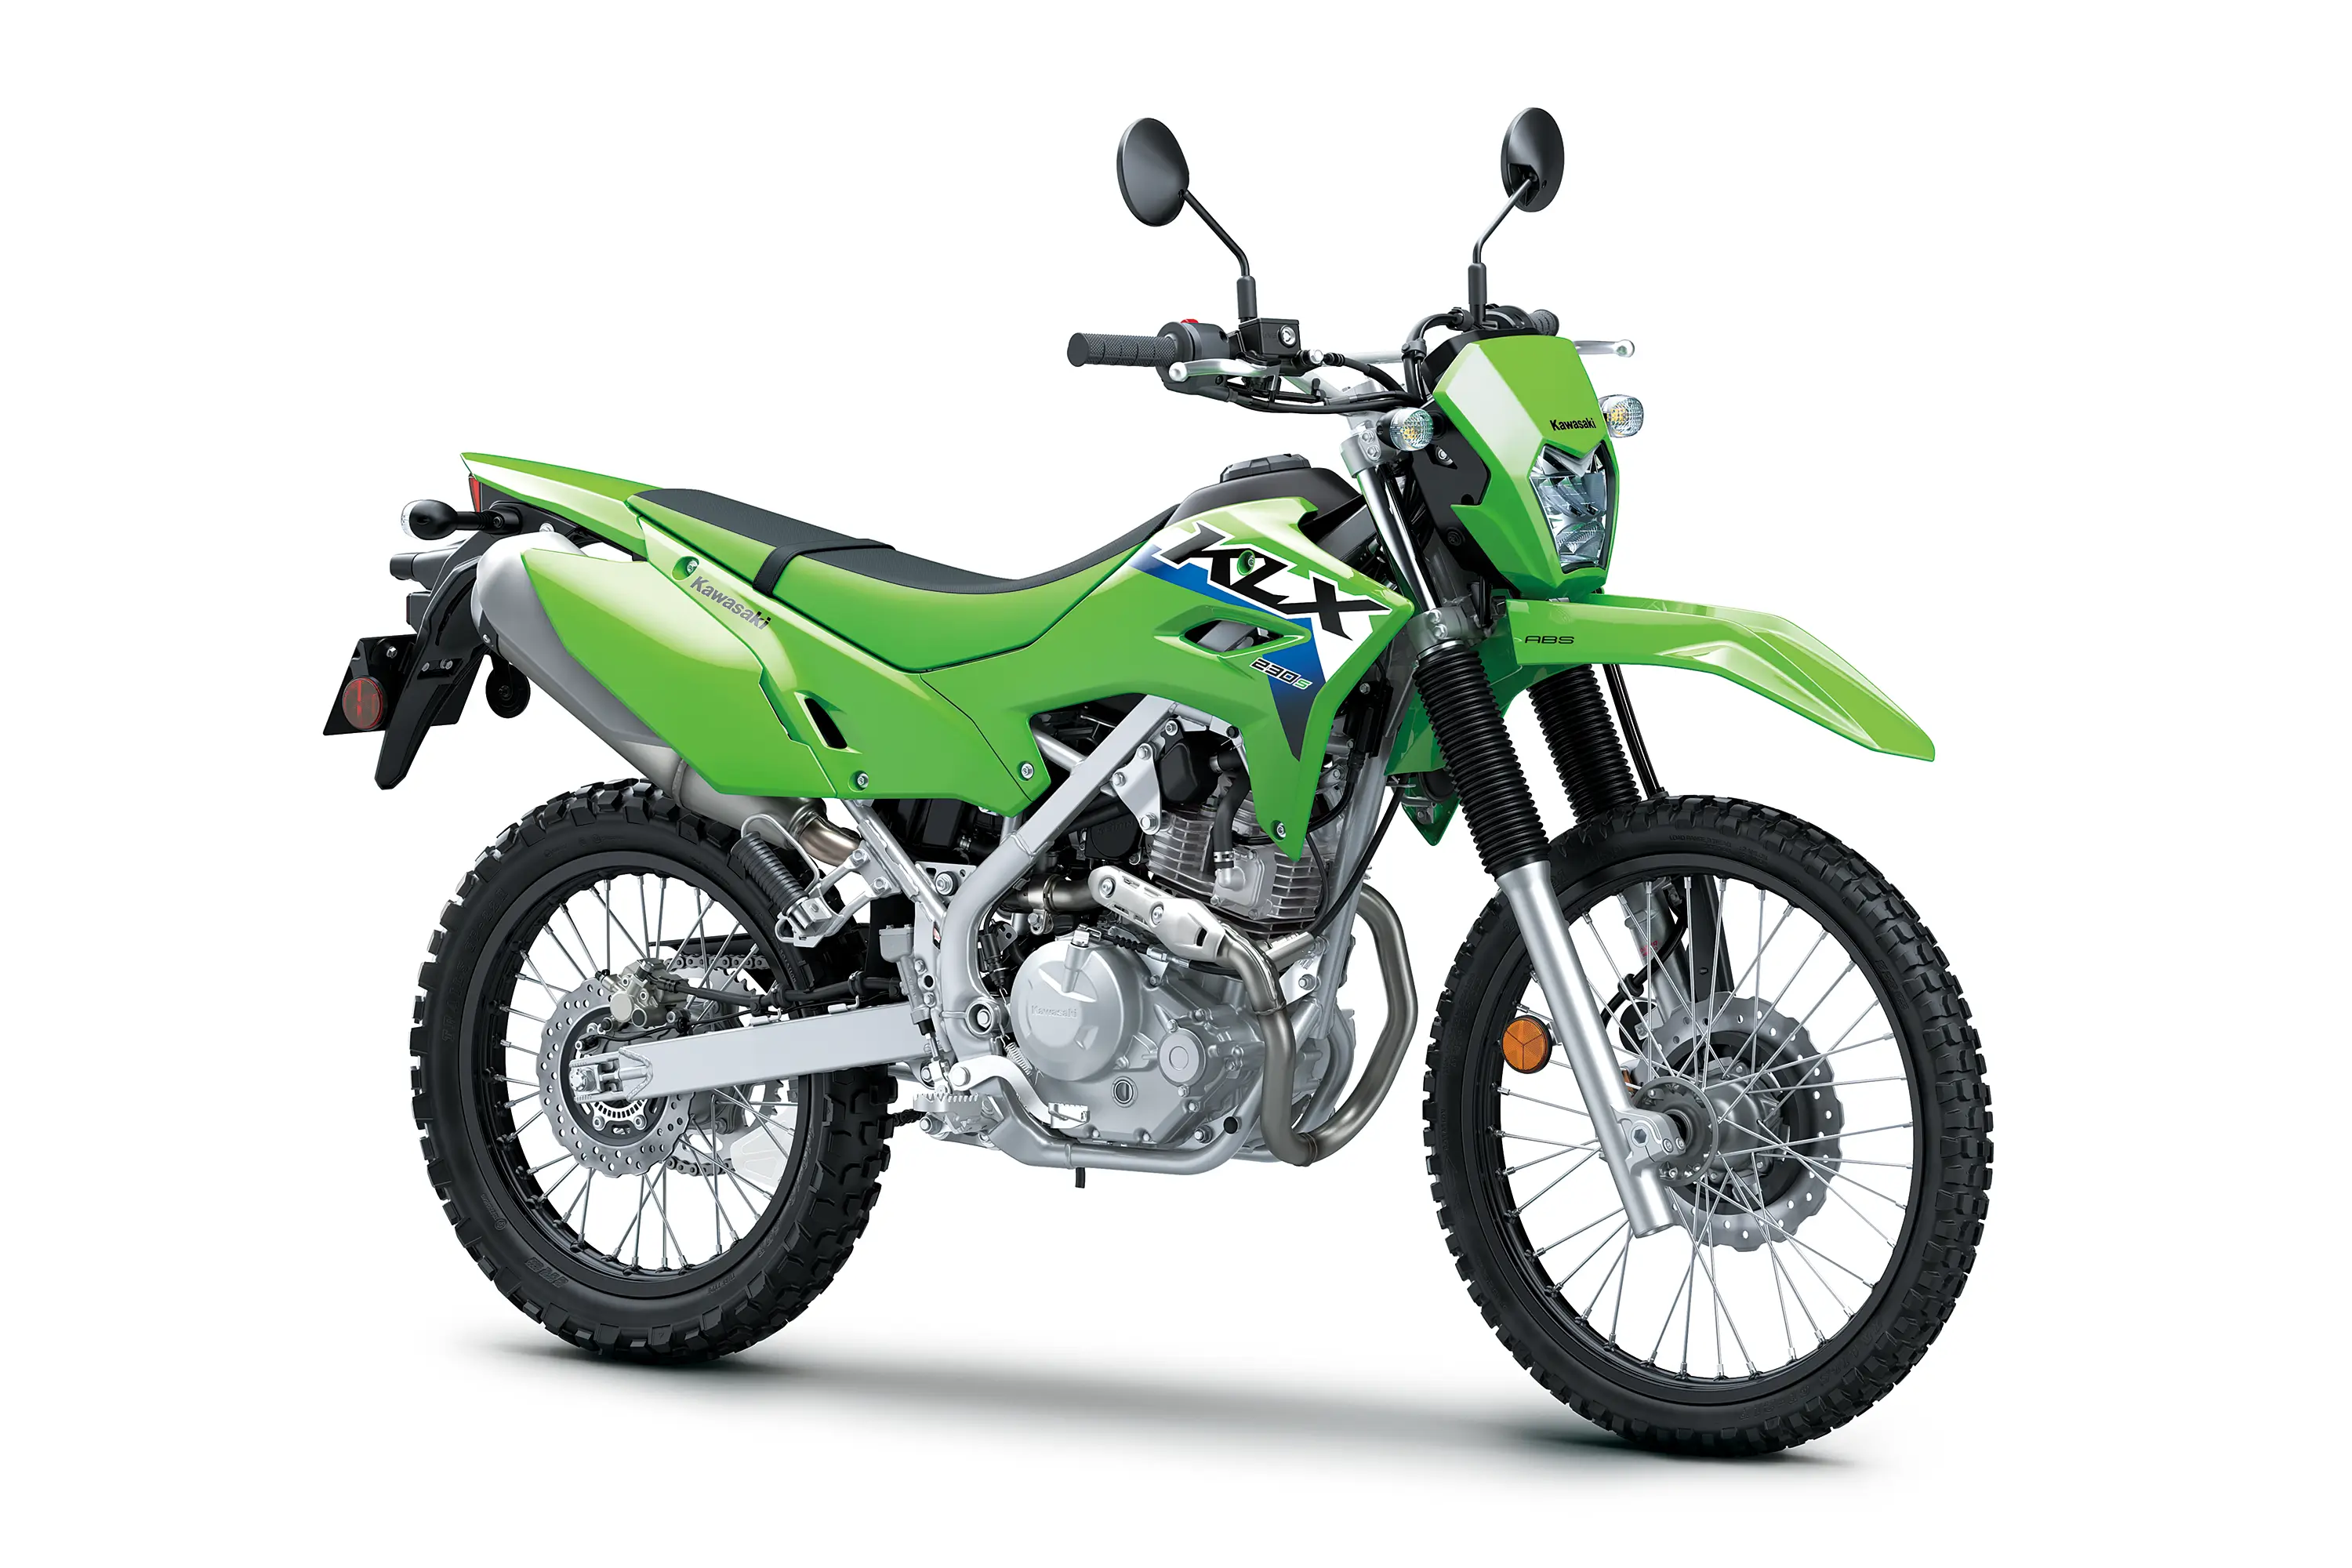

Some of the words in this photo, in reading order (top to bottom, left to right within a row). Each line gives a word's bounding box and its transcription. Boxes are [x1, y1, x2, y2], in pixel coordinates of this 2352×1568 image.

[1549, 417, 1596, 431] Kawasaki
[1159, 521, 1392, 641] KLX
[690, 576, 771, 630] Kawasaki
[1525, 635, 1574, 644] ABS
[1031, 1004, 1078, 1019] Kawasaki
